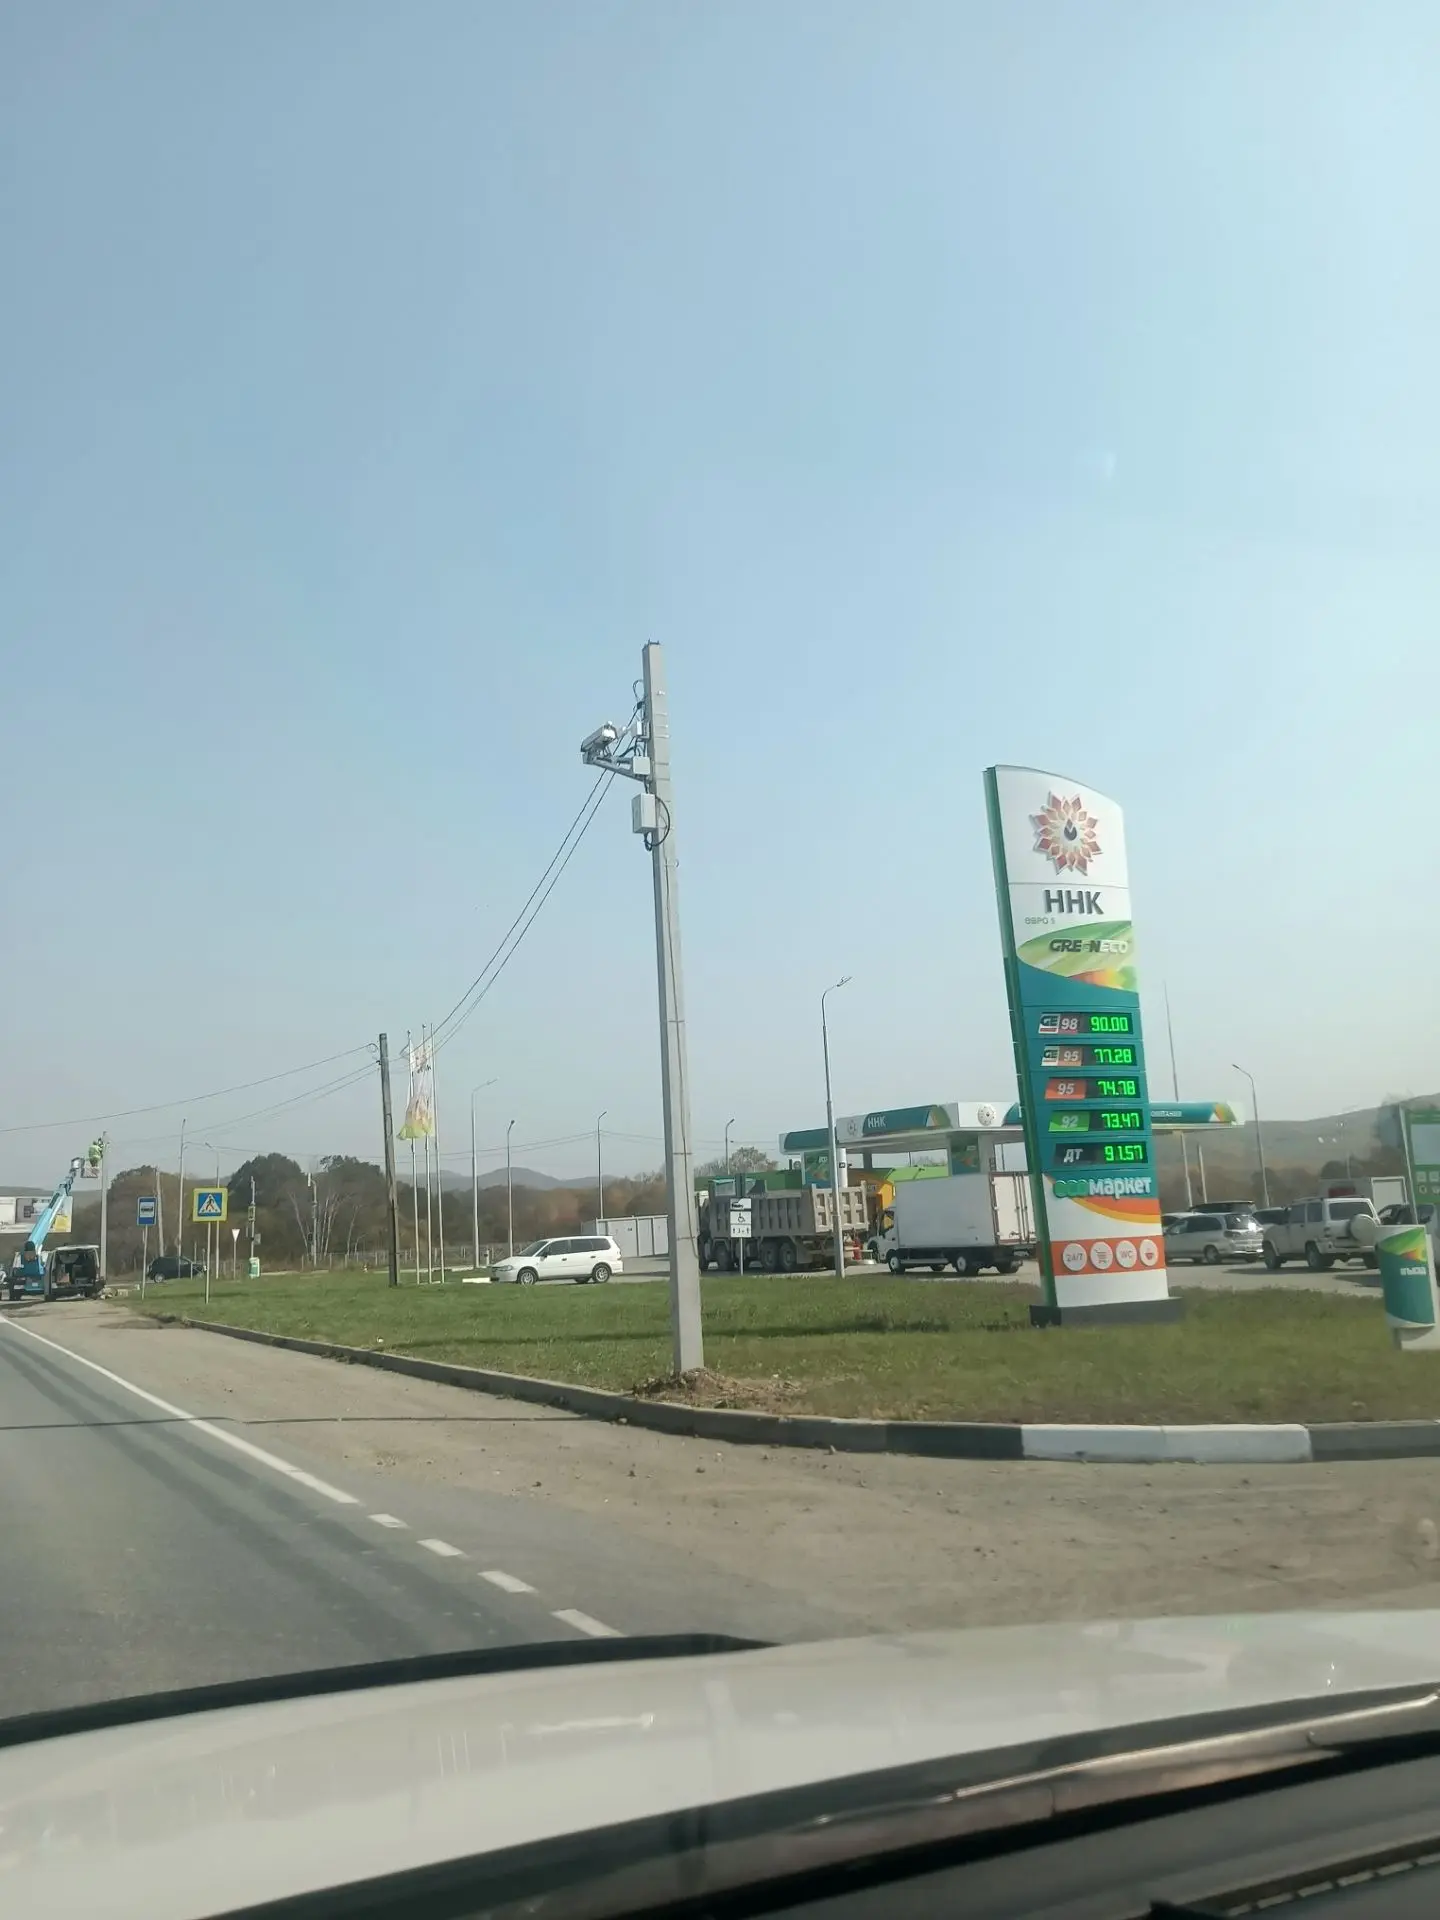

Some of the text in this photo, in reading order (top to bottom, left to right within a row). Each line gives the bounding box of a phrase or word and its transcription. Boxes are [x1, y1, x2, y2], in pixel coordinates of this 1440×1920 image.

[1044, 890, 1104, 914] ННК
[1061, 1018, 1078, 1030] 98
[1090, 1016, 1129, 1032] 90.00
[1063, 1051, 1079, 1062] 95
[1094, 1048, 1132, 1063] 77.28
[1057, 1081, 1136, 1095] 95 74.78
[867, 1116, 886, 1128] ННК
[1062, 1115, 1079, 1128] 92
[1101, 1113, 1140, 1128] 73.47
[1063, 1145, 1143, 1163] ДТ 91.57
[1065, 1252, 1083, 1262] 24/7
[1120, 1249, 1133, 1259] WC
